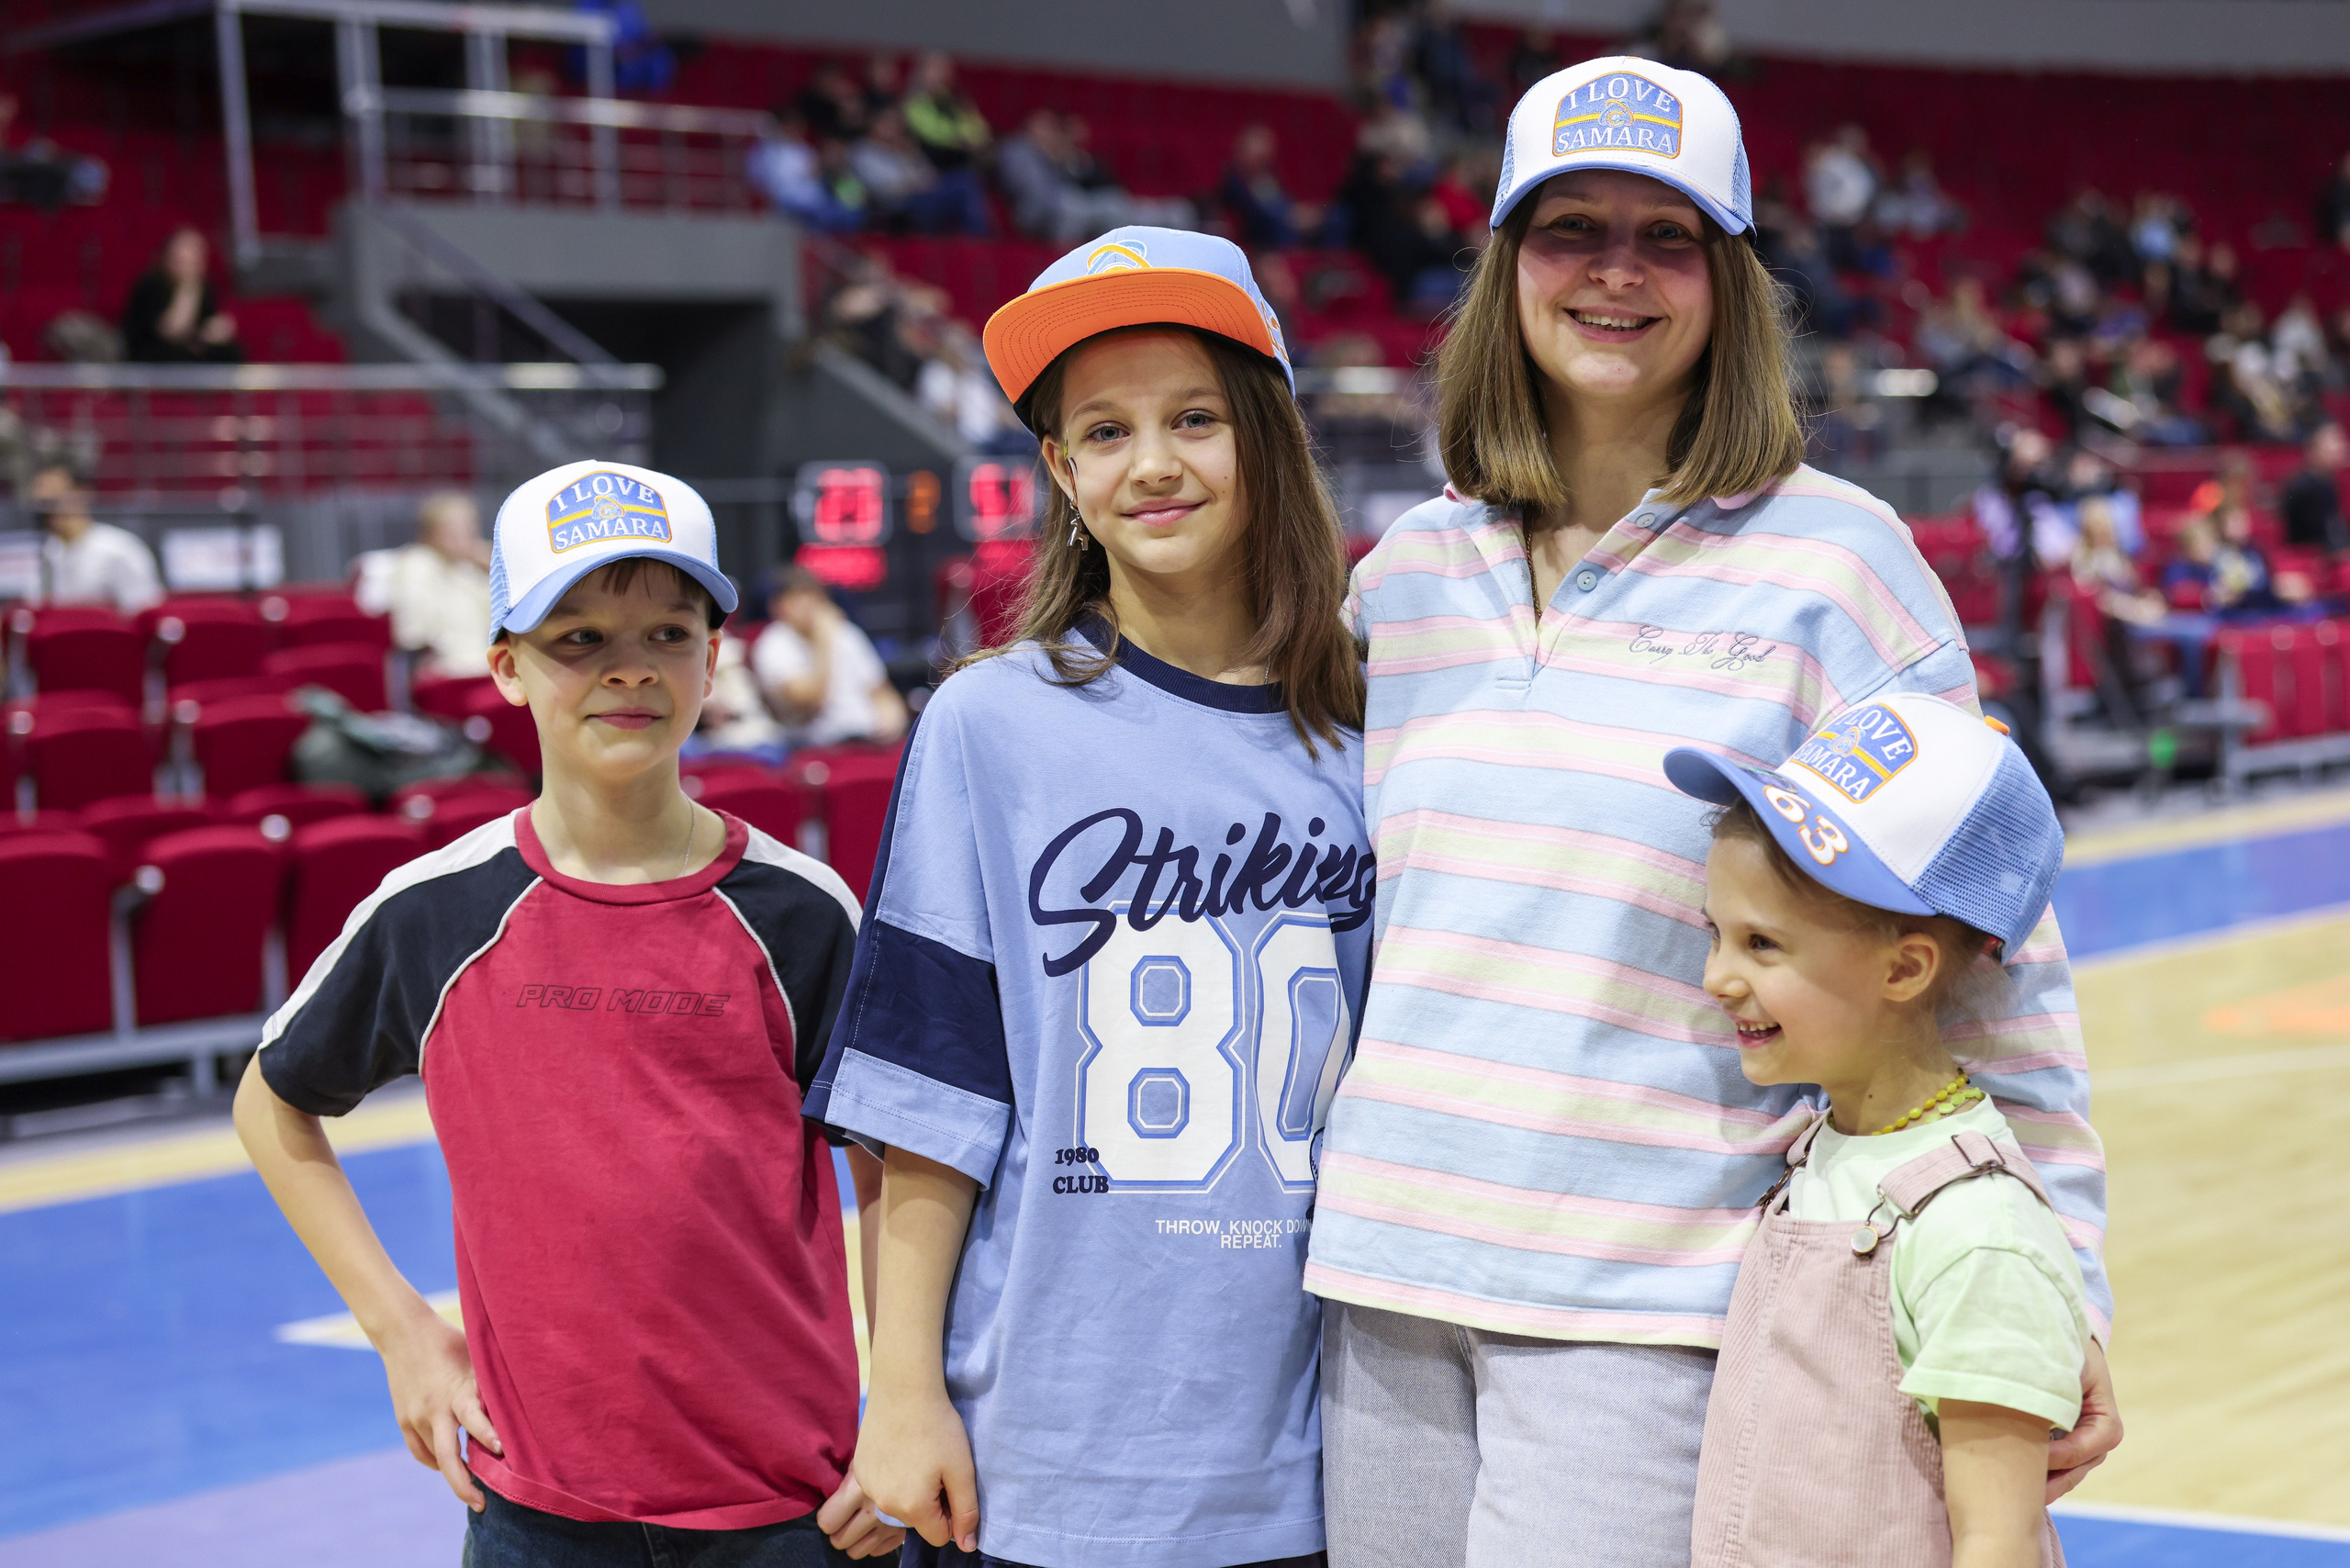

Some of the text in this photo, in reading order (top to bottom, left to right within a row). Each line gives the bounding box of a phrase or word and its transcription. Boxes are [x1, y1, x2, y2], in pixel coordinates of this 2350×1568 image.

[1568, 77, 1675, 112] I LOVE
[1557, 127, 1674, 154] SAMARA
[553, 476, 655, 512] I LOVE
[554, 517, 668, 550] SAMARA
[1678, 630, 1724, 655] The
[1710, 631, 1777, 672] Good
[1843, 707, 1913, 761] LOVE
[1762, 784, 1851, 867] 63
[1028, 808, 1377, 977] Striking
[516, 984, 732, 1017] PRO MODE
[1072, 900, 1354, 1194] 80
[1054, 1146, 1100, 1167] 1980
[1052, 1175, 1109, 1194] CLUB
[1155, 1219, 1225, 1235] THROW.
[1229, 1219, 1283, 1235] KNOCK
[1220, 1234, 1282, 1249] REPEAT.
